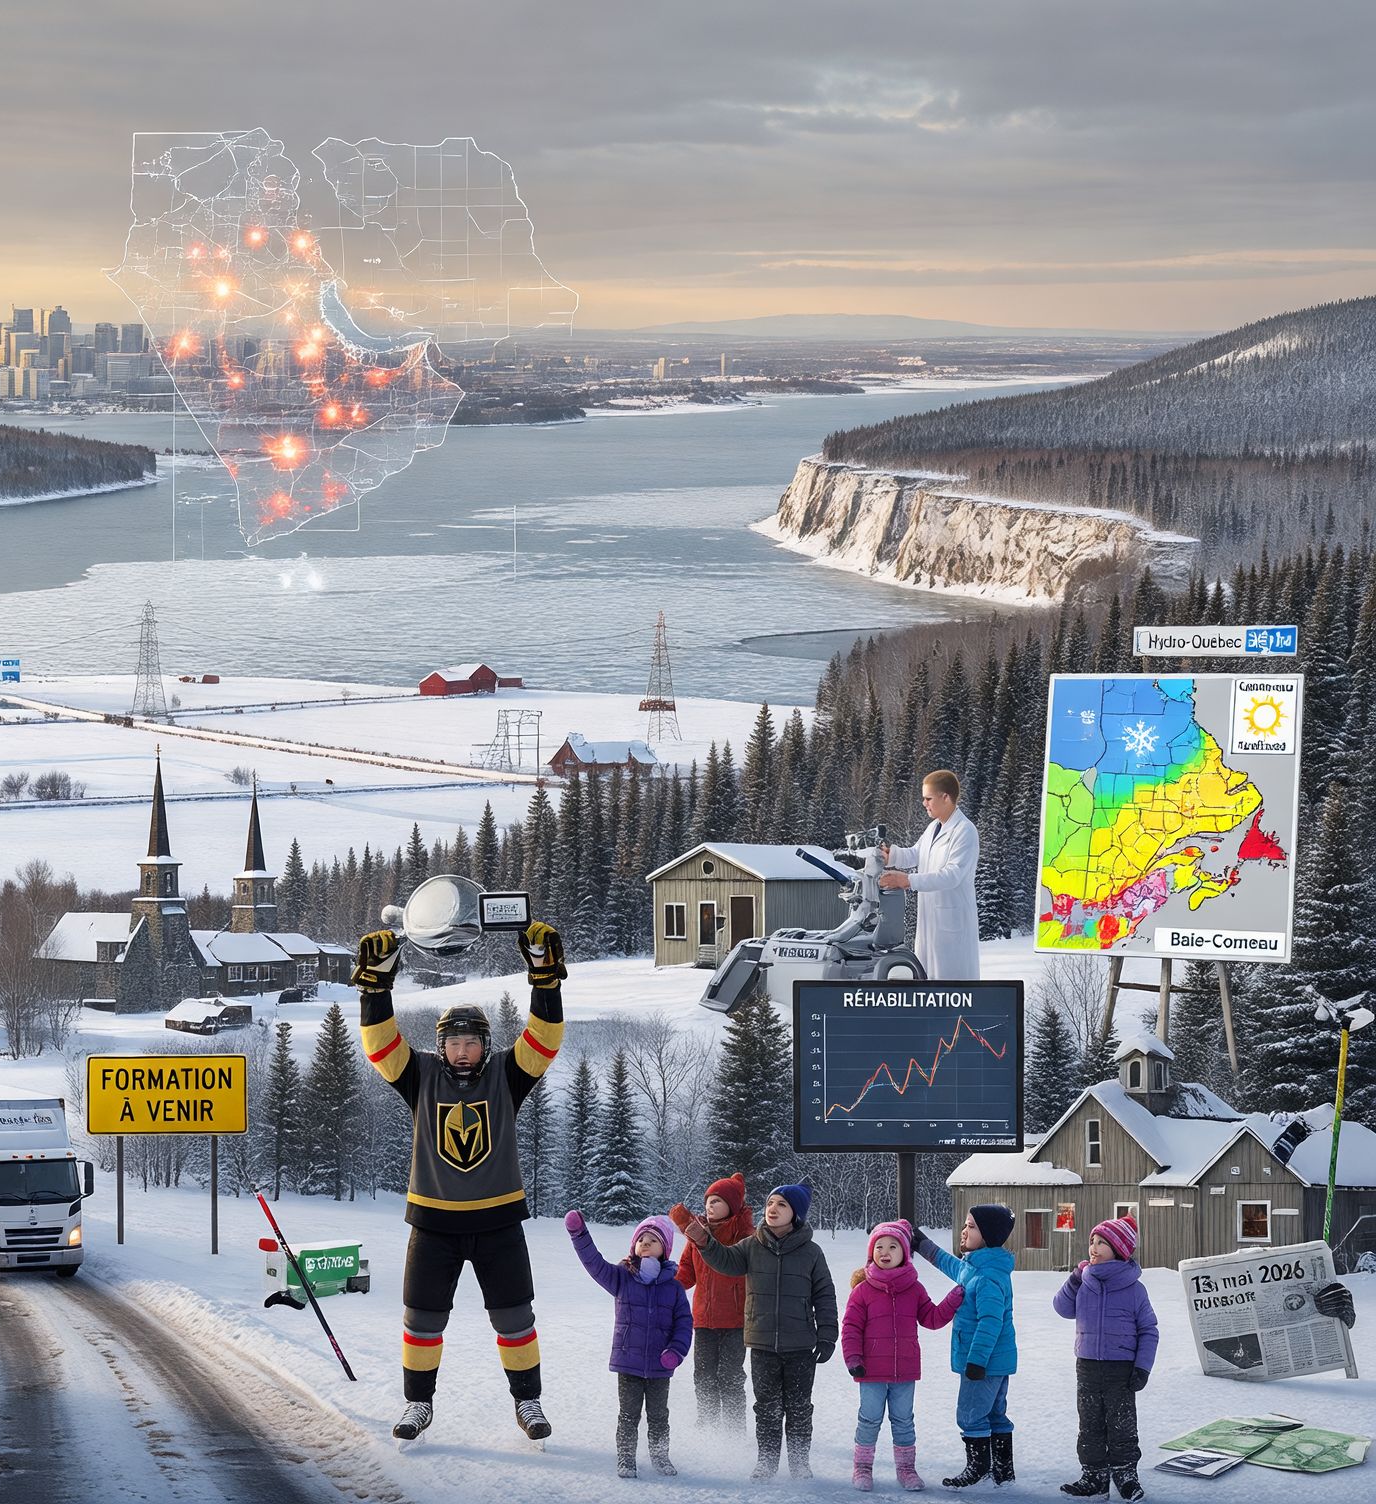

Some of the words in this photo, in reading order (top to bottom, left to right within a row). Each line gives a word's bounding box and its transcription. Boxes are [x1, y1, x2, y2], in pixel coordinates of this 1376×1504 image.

[1170, 932, 1278, 951] Baie-Comeau
[843, 988, 973, 1008] RÉHABILITATION
[101, 1067, 233, 1091] FORMATION
[119, 1097, 135, 1122] À
[146, 1099, 215, 1122] VENIR
[1258, 1260, 1305, 1284] 2026
